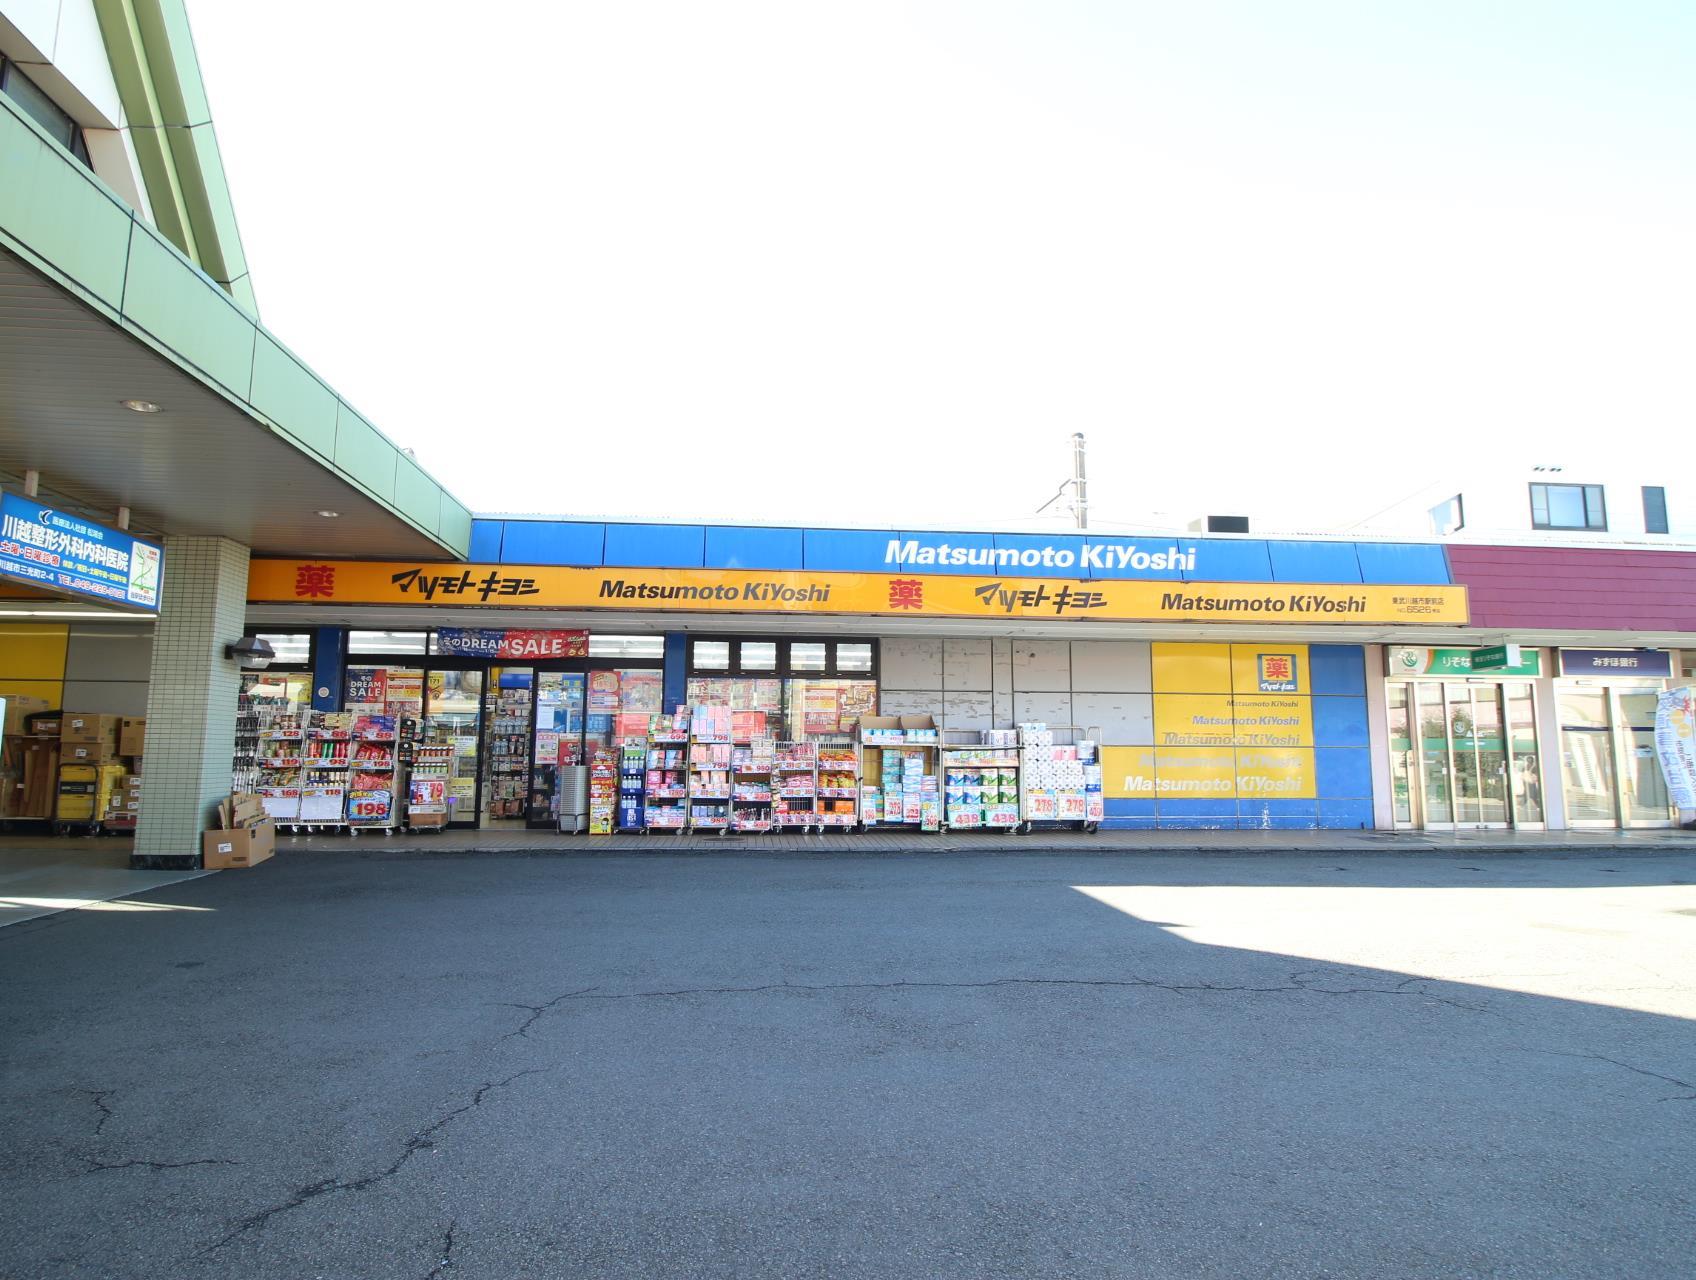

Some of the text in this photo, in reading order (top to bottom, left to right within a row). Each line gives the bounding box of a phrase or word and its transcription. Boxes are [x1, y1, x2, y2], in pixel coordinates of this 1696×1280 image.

[1, 514, 129, 572] 川越整形外科内科医院
[0, 540, 60, 567] 土曜・日曜診療
[884, 540, 1196, 571] Matsumoto KiYoshi
[295, 565, 336, 598] 薬
[391, 568, 540, 602] マツモトキヨシ
[599, 580, 830, 602] Matsumoto KiYoshi
[889, 578, 923, 610] 薬
[975, 582, 1108, 615] マツモトキヨシ
[1160, 593, 1366, 613] Matsumoto KiYoshi
[510, 638, 563, 656] SALE
[1264, 657, 1289, 679] 薬
[1592, 657, 1639, 668] みずほ銀行
[350, 687, 381, 697] SALE
[1270, 700, 1299, 708] KiYoshi
[1192, 715, 1300, 726] Matsumoto KiYoshi
[1164, 732, 1300, 746] Matsumoto KiYoshi
[1123, 775, 1302, 792] Matsumoto KiYoshi
[356, 803, 387, 816] 198
[1034, 799, 1053, 812] 278
[1066, 799, 1085, 813] 278
[955, 813, 979, 824] 438
[992, 813, 1016, 824] 438
